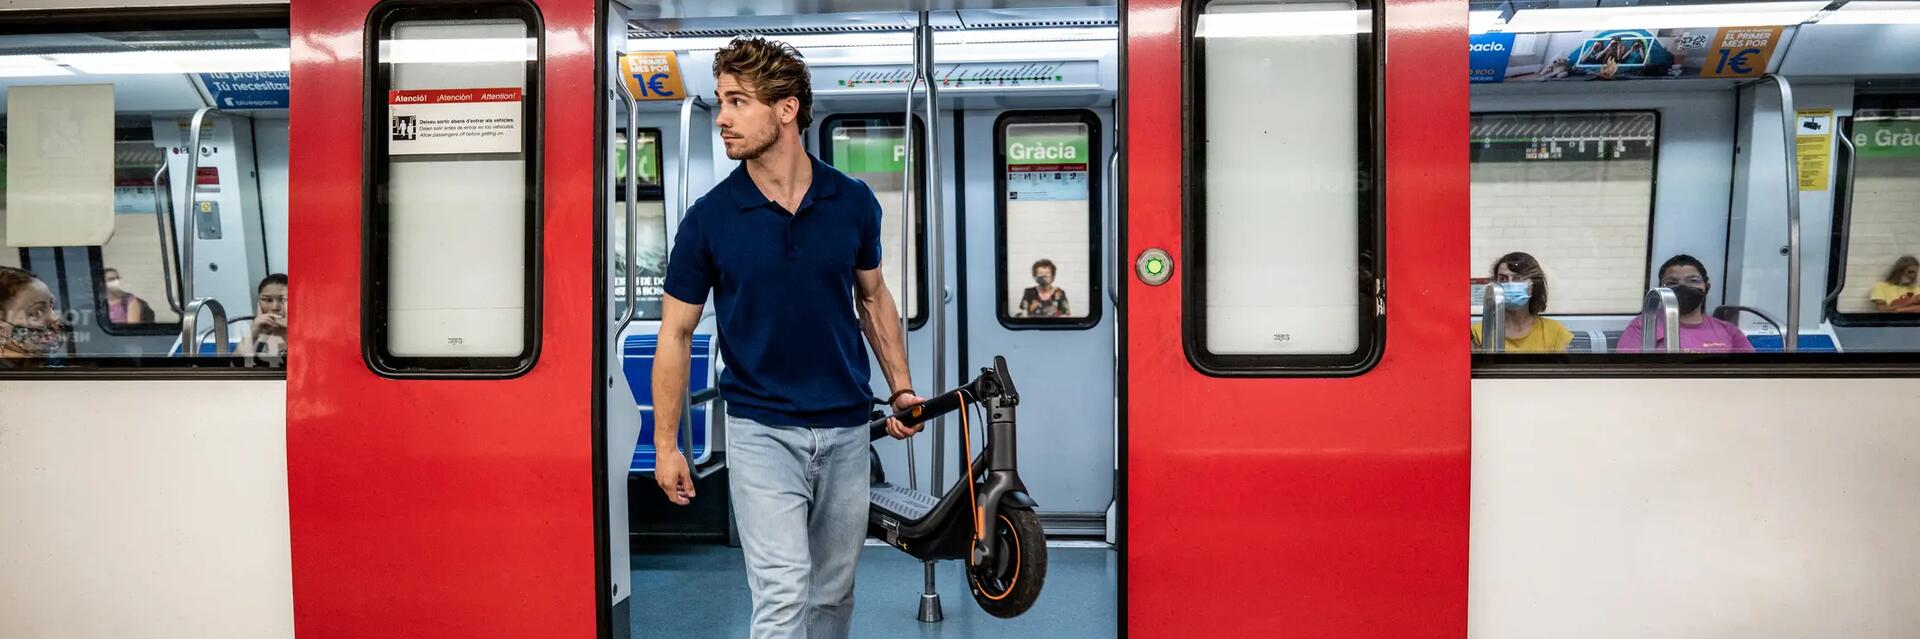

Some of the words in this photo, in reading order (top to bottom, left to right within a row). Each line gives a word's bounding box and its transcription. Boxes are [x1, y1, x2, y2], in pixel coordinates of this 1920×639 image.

[1736, 32, 1771, 40] PRIMER
[1744, 39, 1768, 47] POR
[1715, 48, 1760, 74] 1€
[213, 81, 231, 92] Tú
[633, 73, 674, 97] 1€
[395, 94, 428, 102] Atenció!
[436, 93, 473, 102] ¡Atención!
[481, 92, 516, 101] Attention!
[1009, 142, 1077, 160] Gràcia
